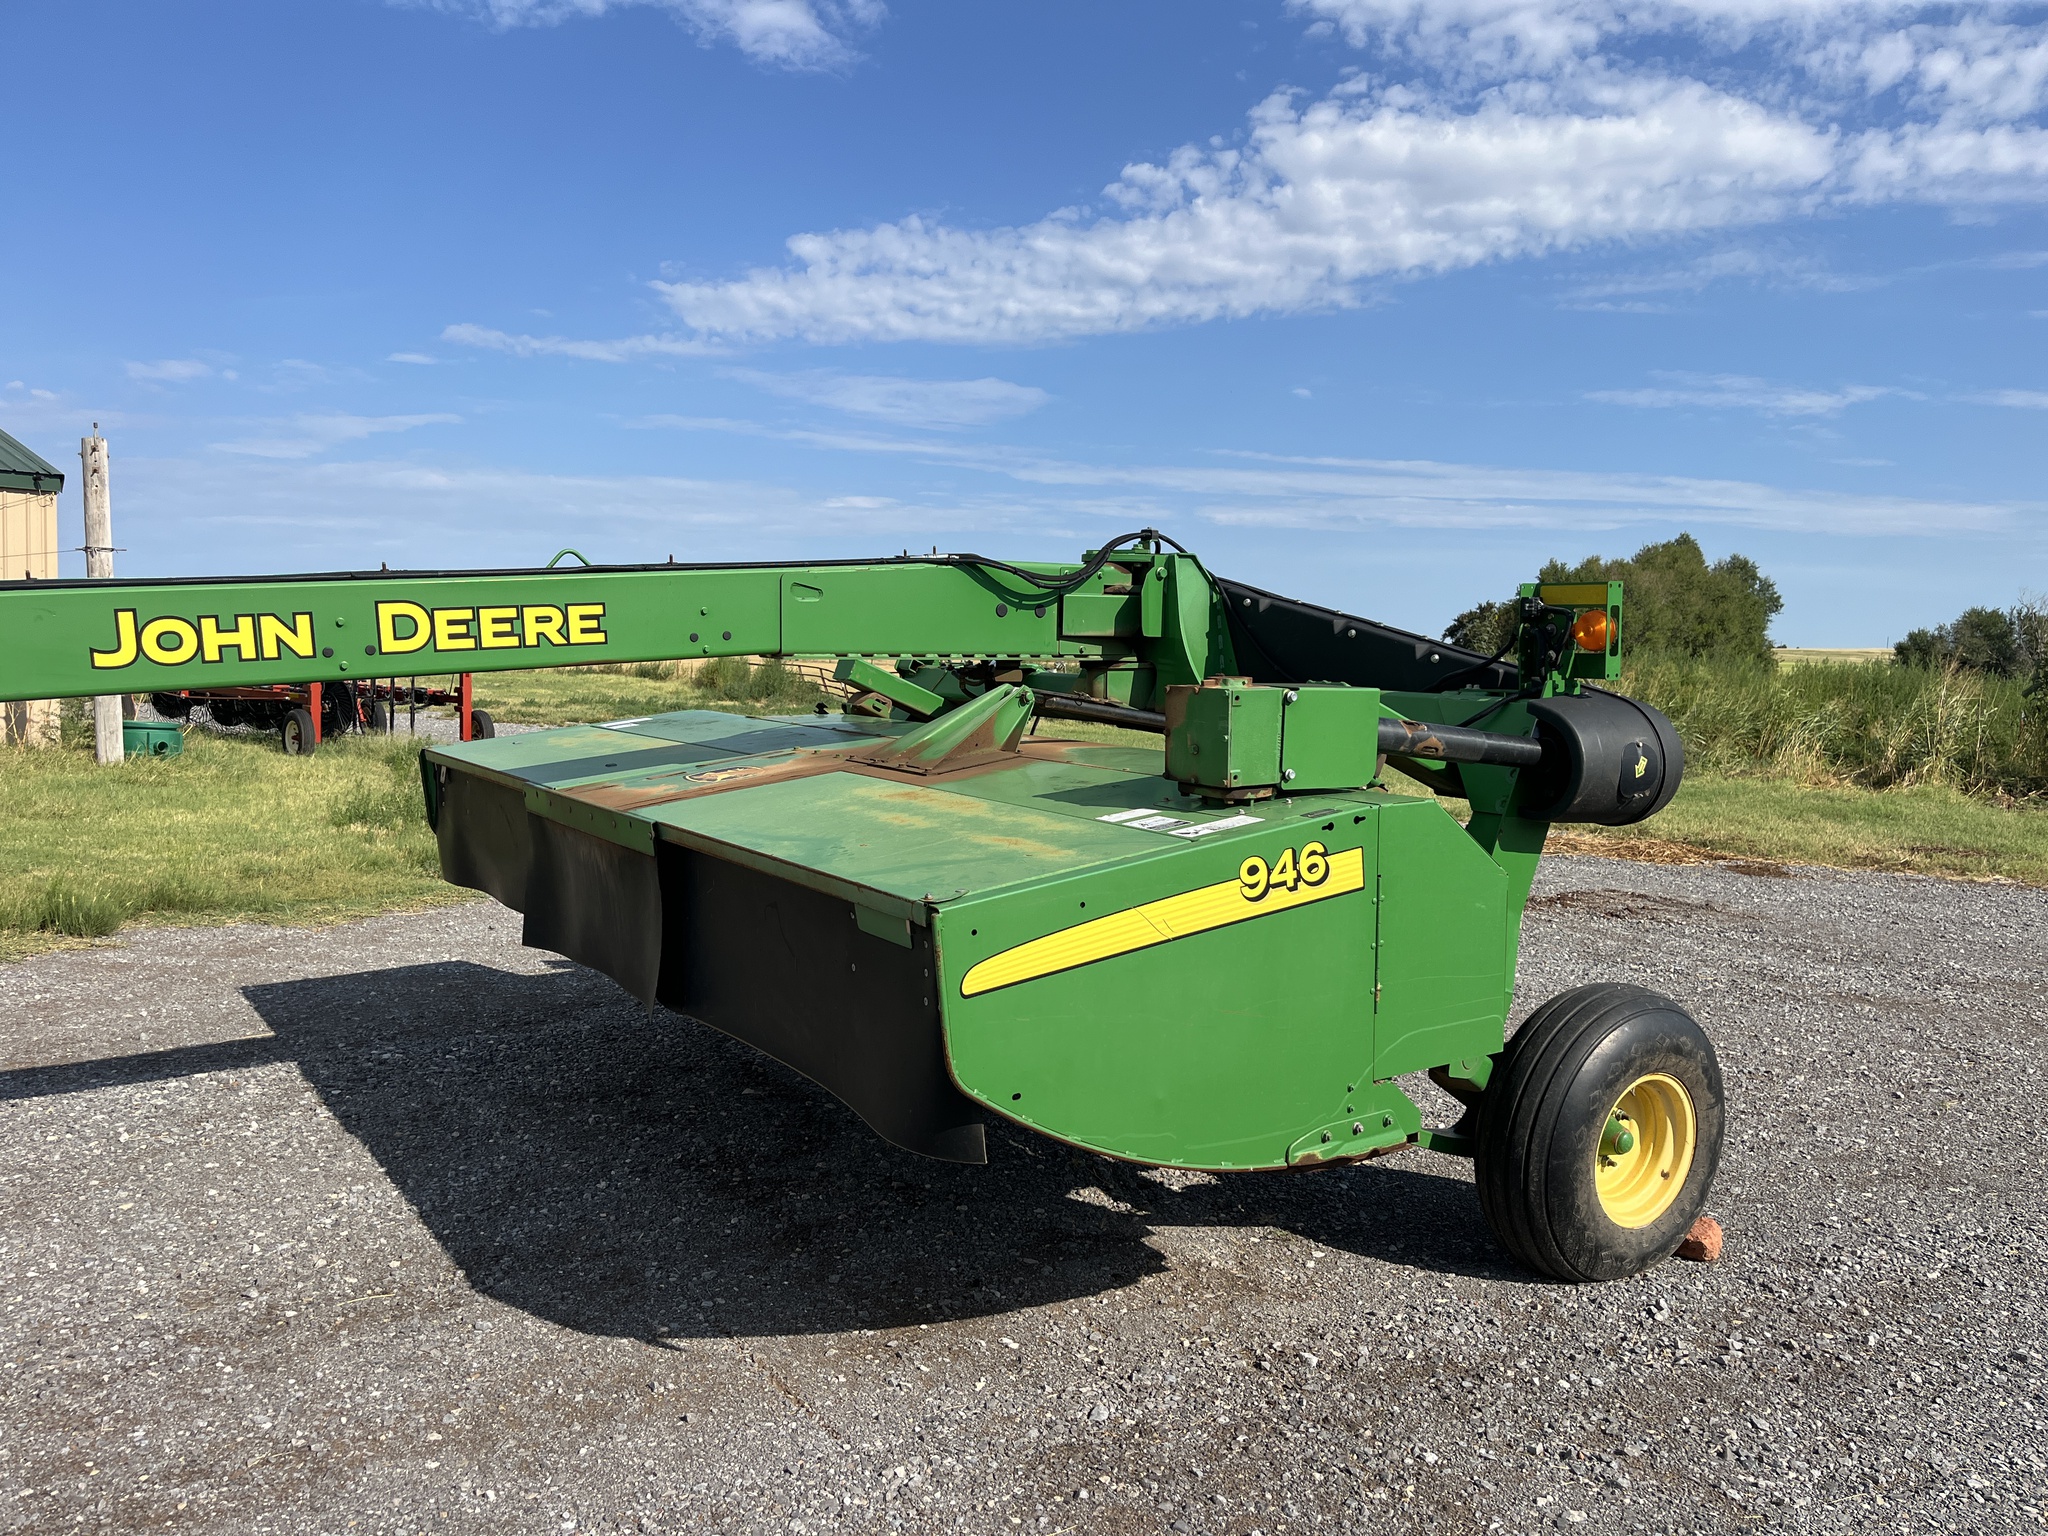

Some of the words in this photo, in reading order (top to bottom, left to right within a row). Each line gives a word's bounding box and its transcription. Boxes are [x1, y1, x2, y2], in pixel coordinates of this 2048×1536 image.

[89, 608, 317, 669] JOHN
[374, 600, 608, 655] DEERE
[1239, 841, 1330, 902] 946
